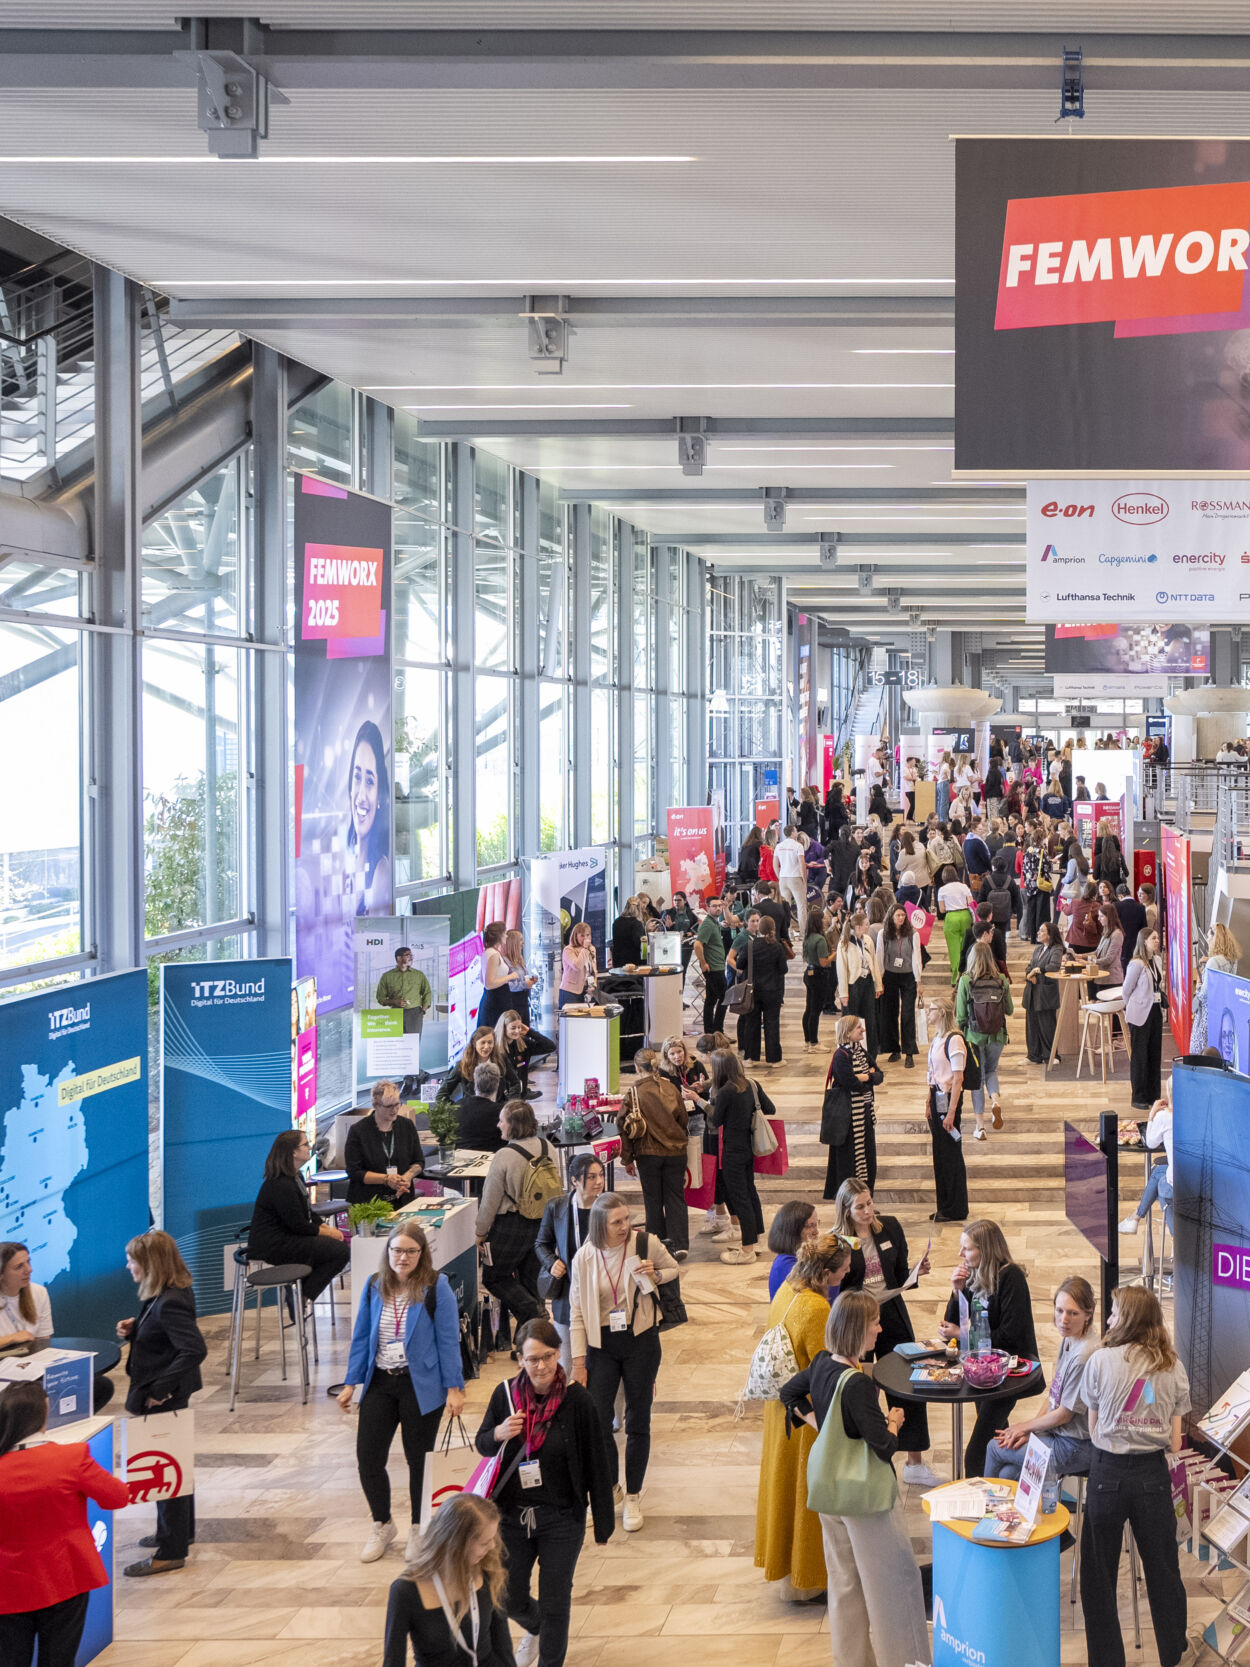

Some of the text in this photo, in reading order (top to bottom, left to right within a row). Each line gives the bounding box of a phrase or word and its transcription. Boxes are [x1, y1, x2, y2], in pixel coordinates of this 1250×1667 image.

[1117, 503, 1164, 515] Henkel
[1052, 556, 1086, 565] amprion
[1098, 553, 1147, 567] Capgemini
[1172, 552, 1226, 566] enercity
[309, 557, 378, 587] FEMWORX
[1056, 593, 1135, 601] Lufthansa Technik
[308, 599, 340, 627] 2025
[868, 671, 885, 686] 15
[899, 671, 918, 686] 18
[674, 826, 708, 837] it's on us
[568, 859, 589, 870] Hughes
[366, 938, 384, 946] HDI
[191, 995, 265, 1008] Digital für Deutschland
[61, 1063, 138, 1101] Digital für Deutschland
[940, 1628, 986, 1664] amprion
